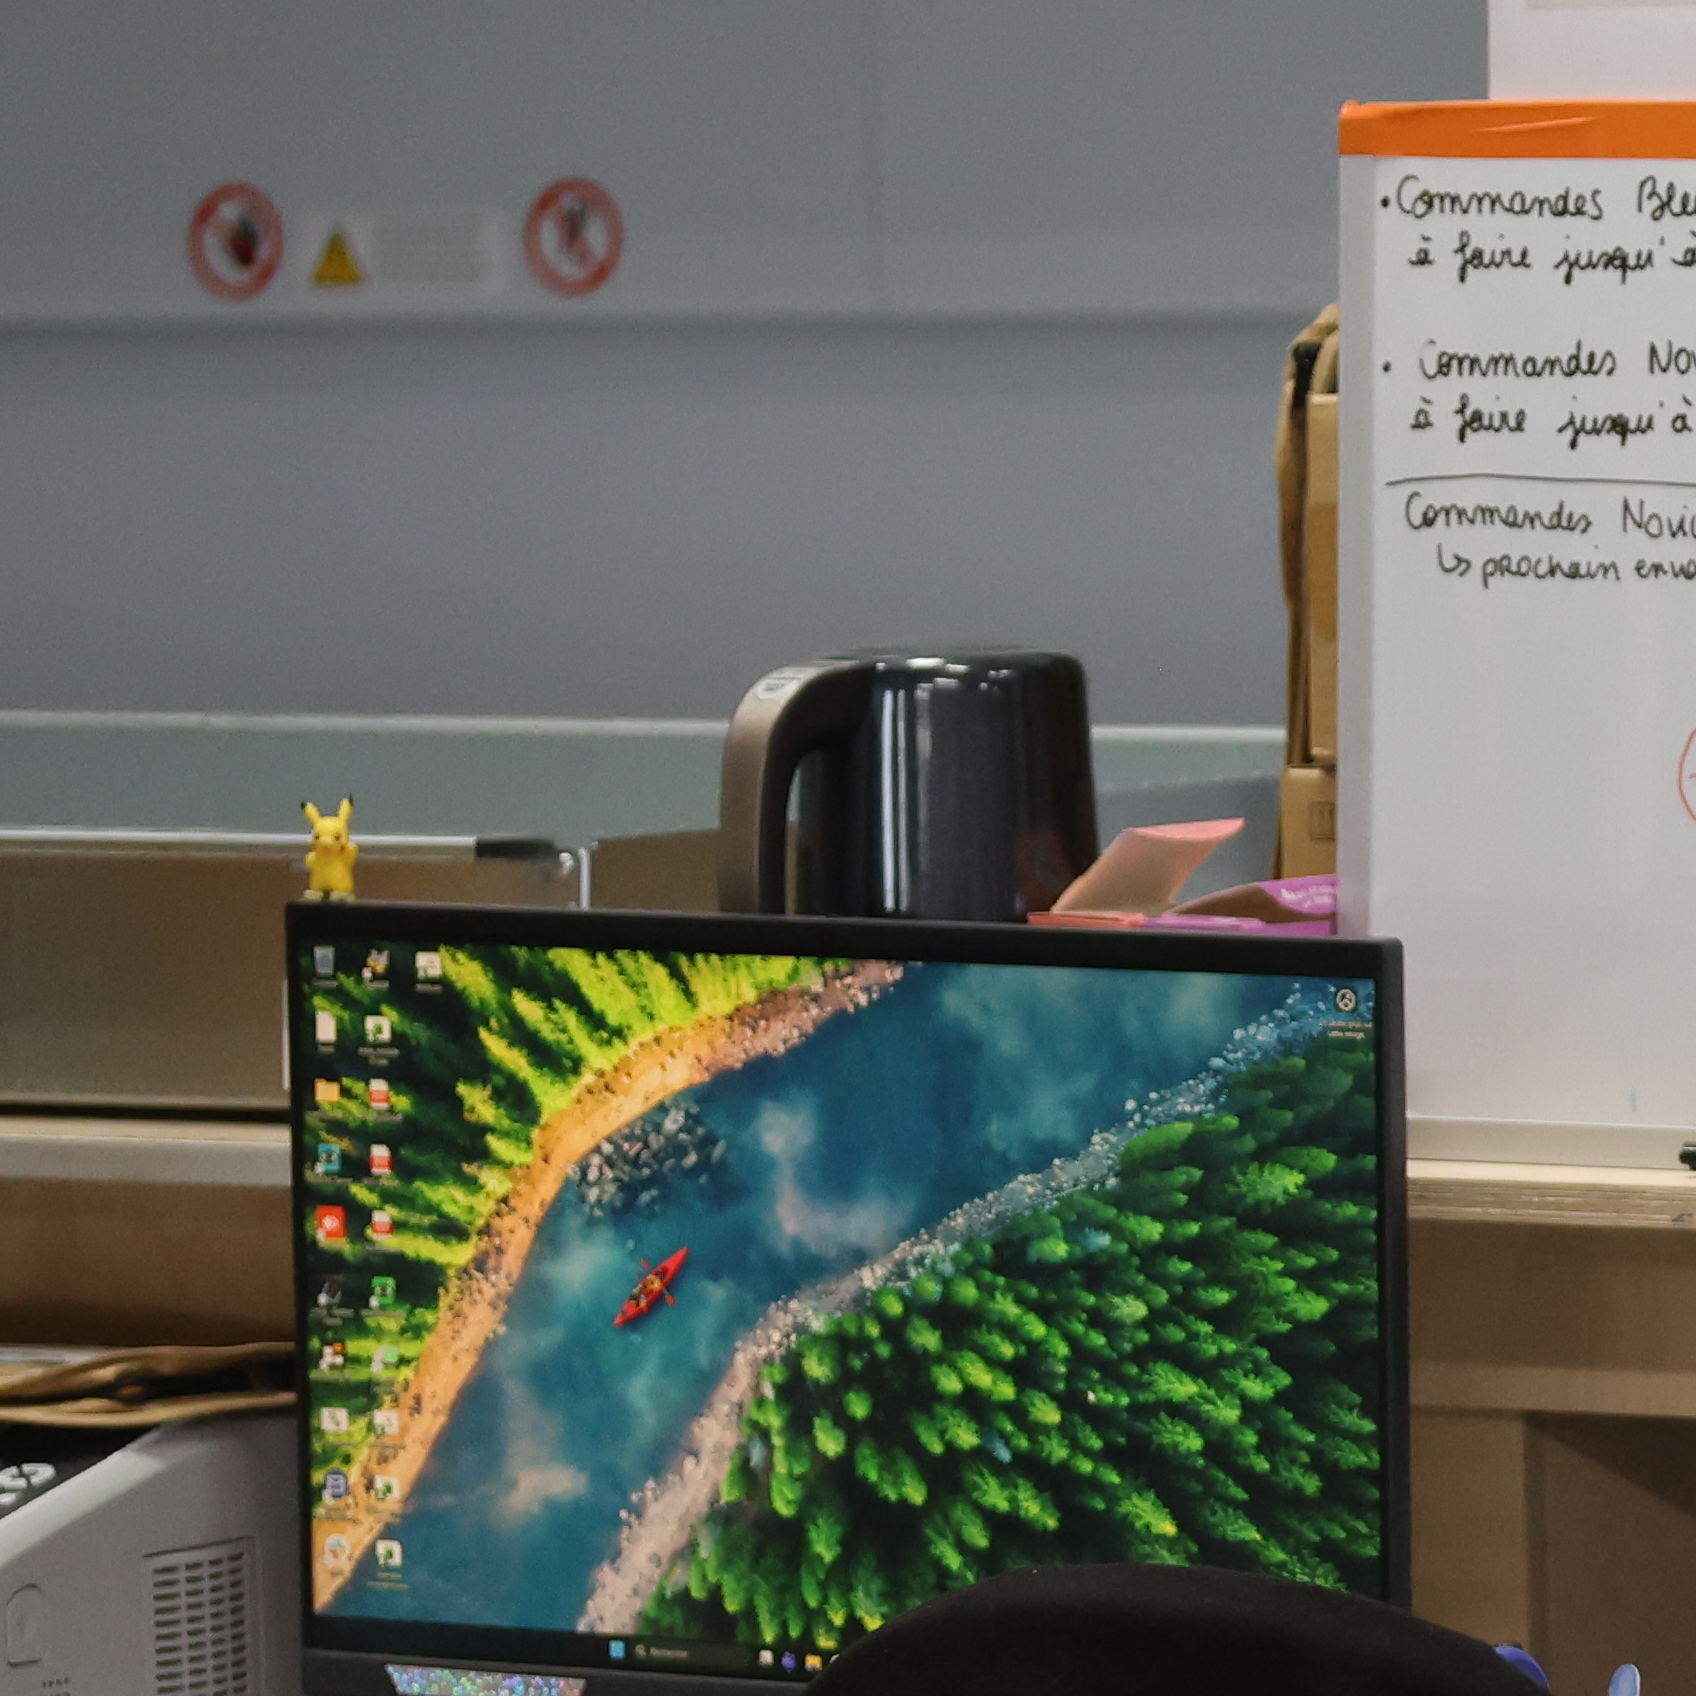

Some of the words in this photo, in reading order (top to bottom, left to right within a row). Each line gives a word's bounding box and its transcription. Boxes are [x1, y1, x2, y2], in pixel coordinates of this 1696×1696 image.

[1397, 174, 1603, 220] Commandes
[1407, 234, 1435, 267] à
[1453, 230, 1532, 284] faire
[1419, 337, 1617, 379] Commandes
[1410, 395, 1434, 430] à
[1453, 392, 1527, 445] faire
[1404, 489, 1594, 536] Commandes
